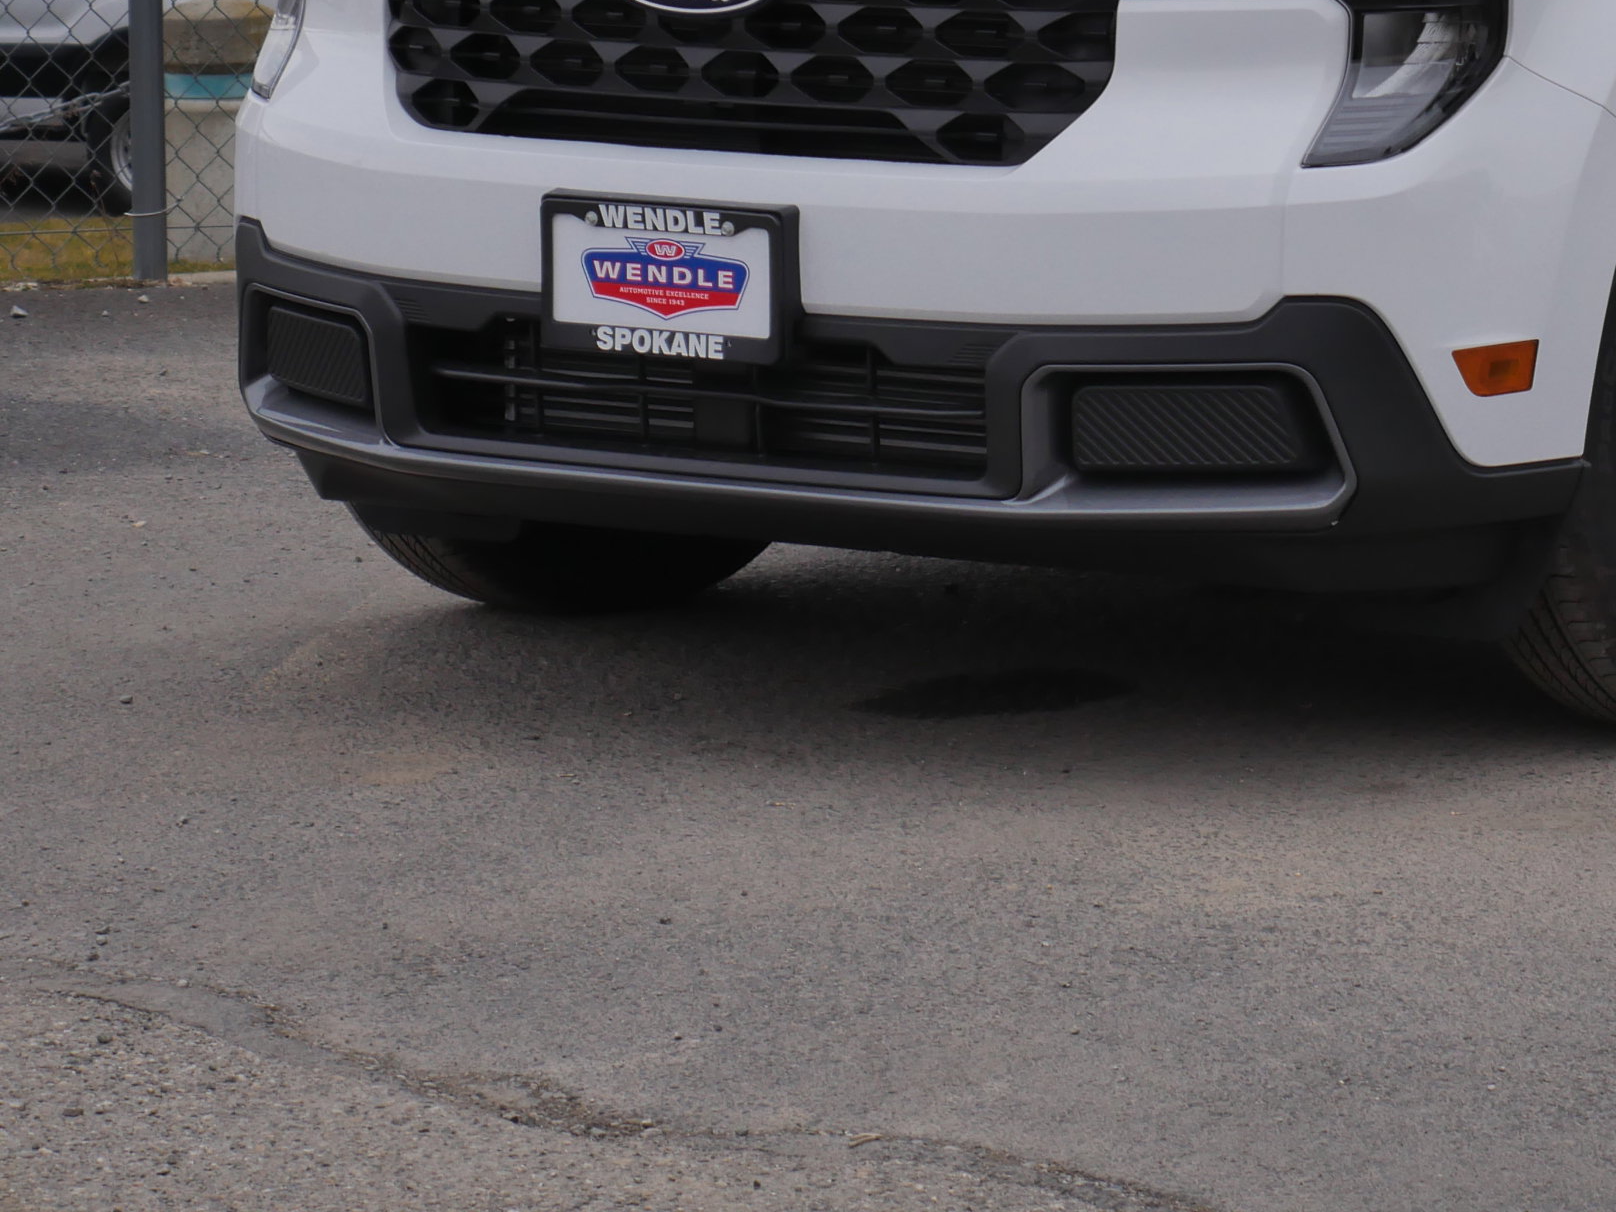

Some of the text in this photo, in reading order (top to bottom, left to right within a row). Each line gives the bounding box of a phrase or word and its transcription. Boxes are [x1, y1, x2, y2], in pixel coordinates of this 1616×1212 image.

[598, 204, 723, 236] WENDLE
[593, 259, 735, 290] WENDLE
[619, 286, 710, 300] AUTOMOTIVE EXCELLENCE
[646, 296, 668, 305] SINCE
[596, 325, 725, 360] SPOKANE
